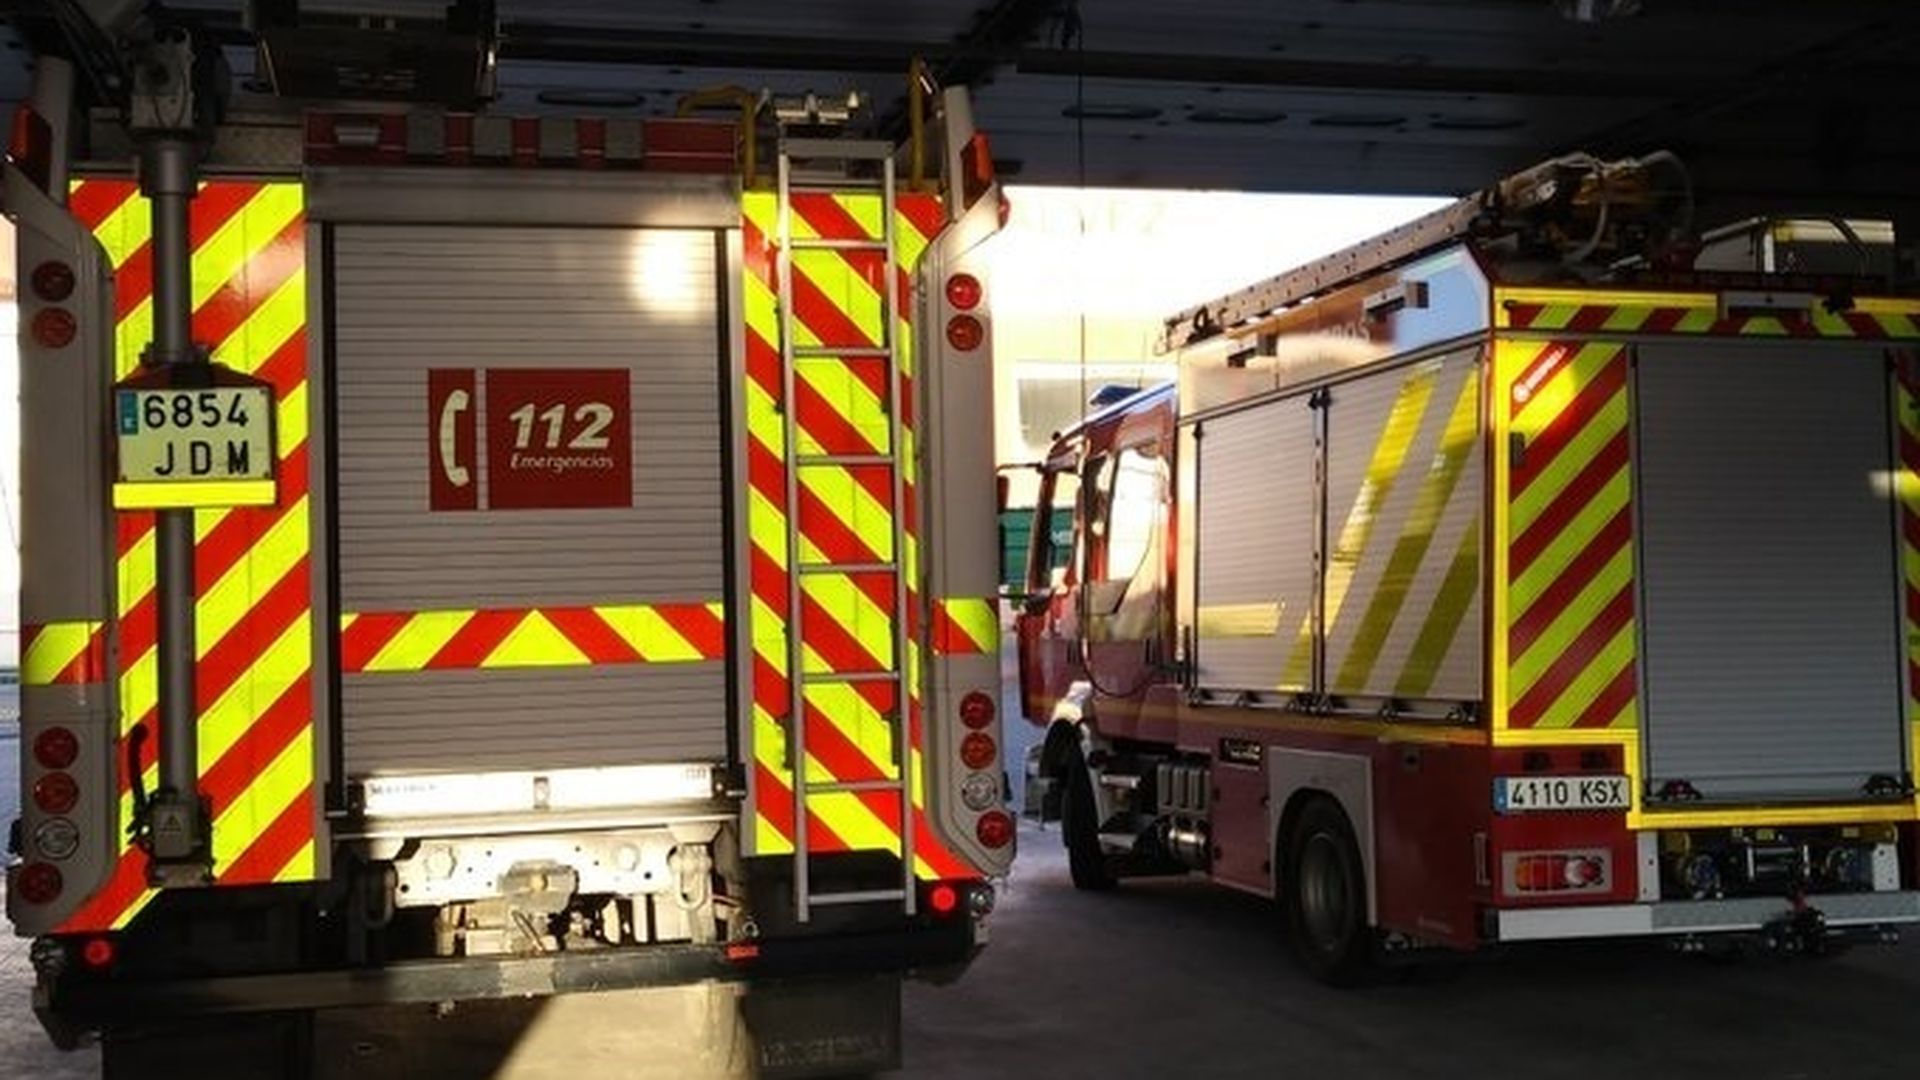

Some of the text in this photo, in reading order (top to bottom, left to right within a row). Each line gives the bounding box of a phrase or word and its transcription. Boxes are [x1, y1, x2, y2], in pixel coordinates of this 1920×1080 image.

[143, 393, 249, 429] 6854
[510, 403, 614, 449] 112
[510, 453, 614, 474] Emergencias
[1511, 780, 1622, 806] 4110 KSX
